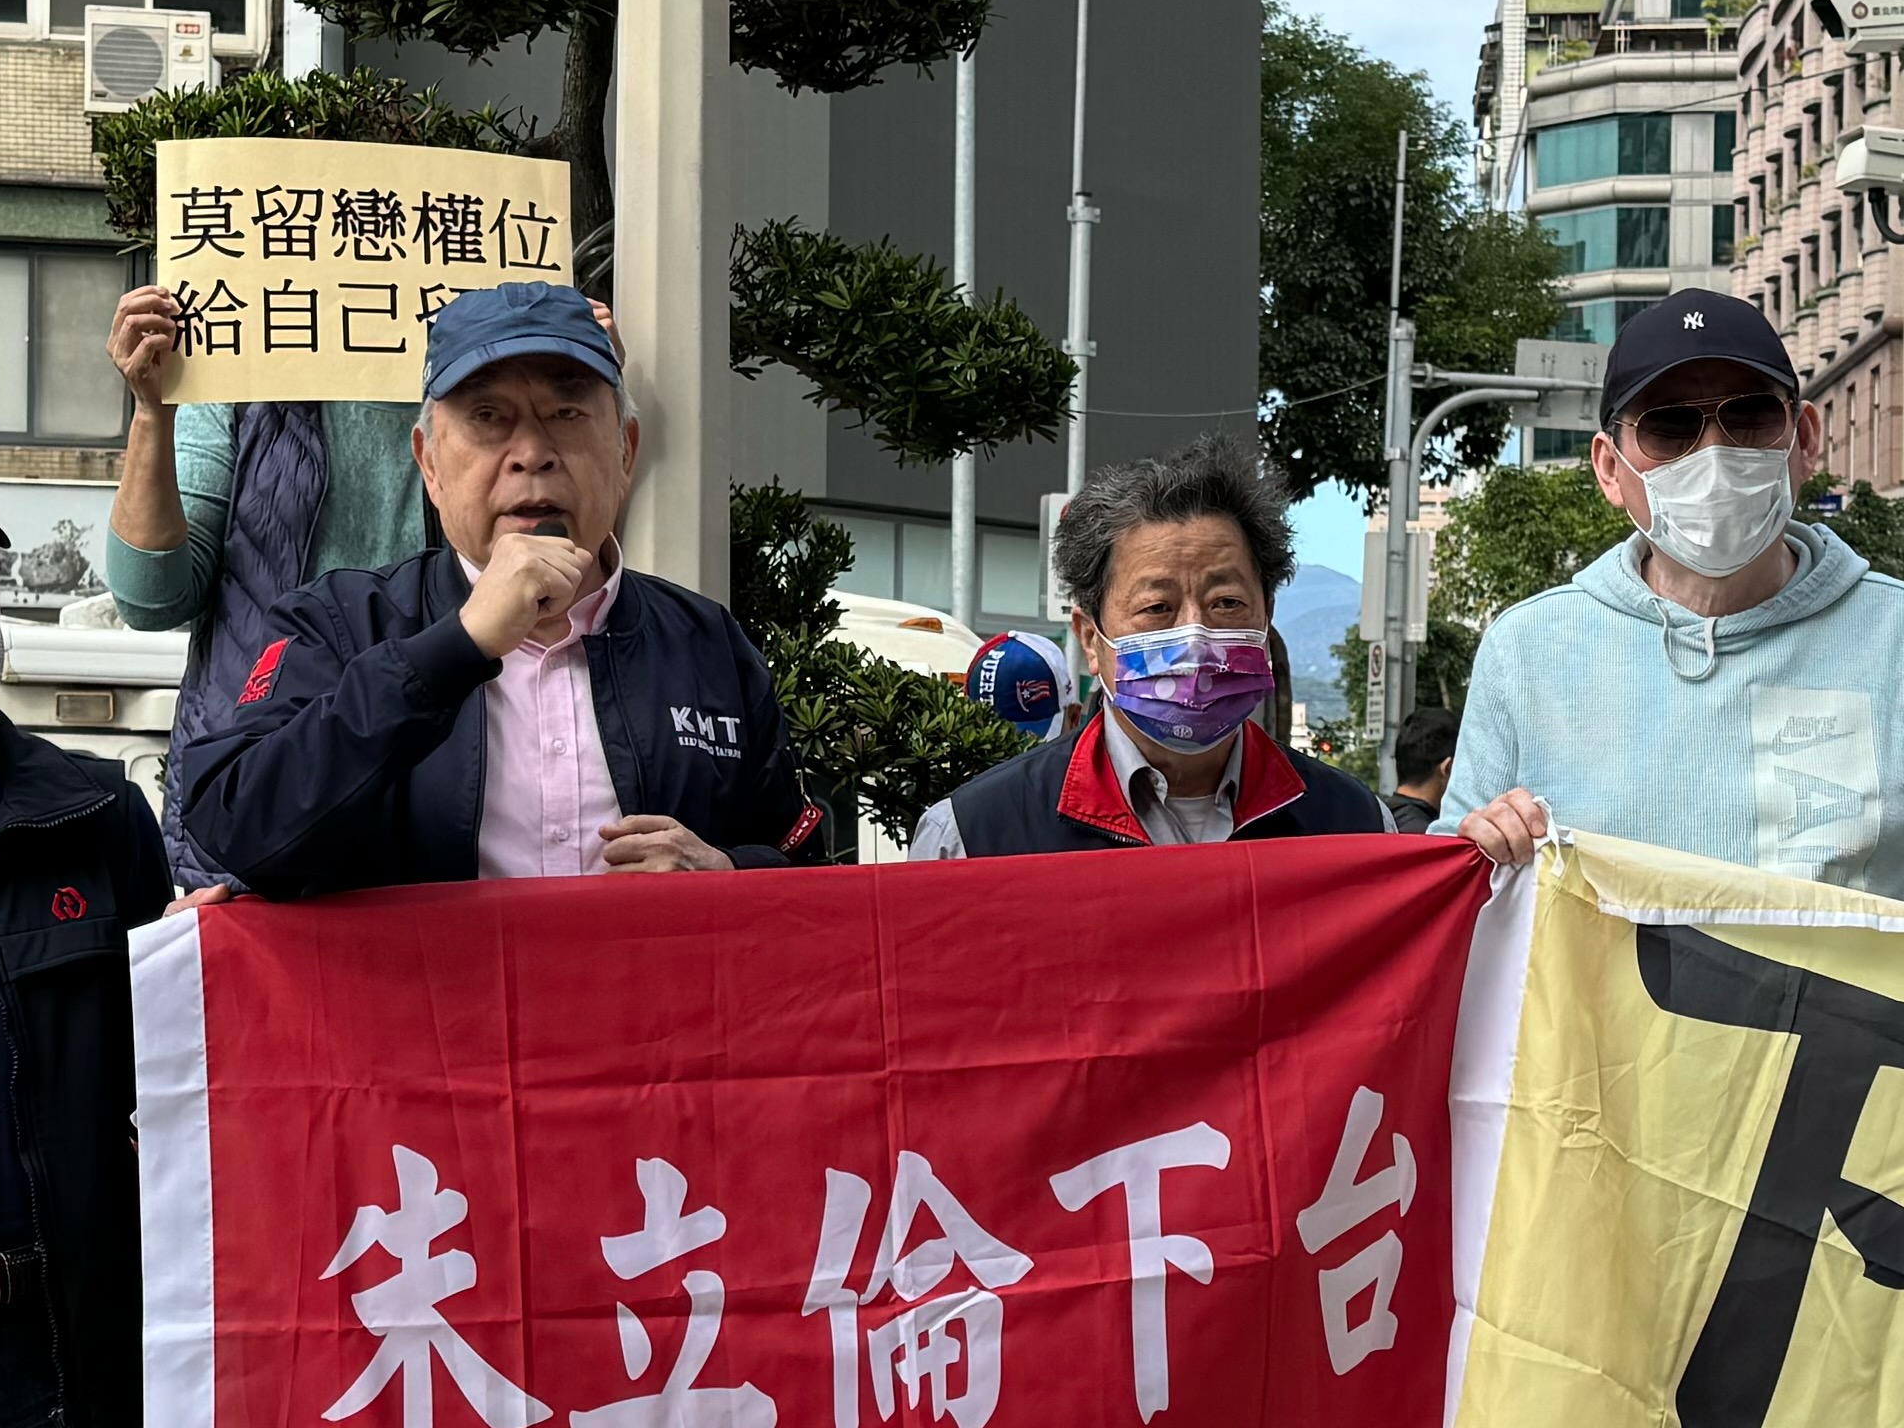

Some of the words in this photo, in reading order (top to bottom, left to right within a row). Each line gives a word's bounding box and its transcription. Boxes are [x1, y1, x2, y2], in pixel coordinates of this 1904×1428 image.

[168, 182, 564, 273] 莫留戀權位
[978, 648, 1007, 707] PUERT
[669, 705, 741, 744] KMT
